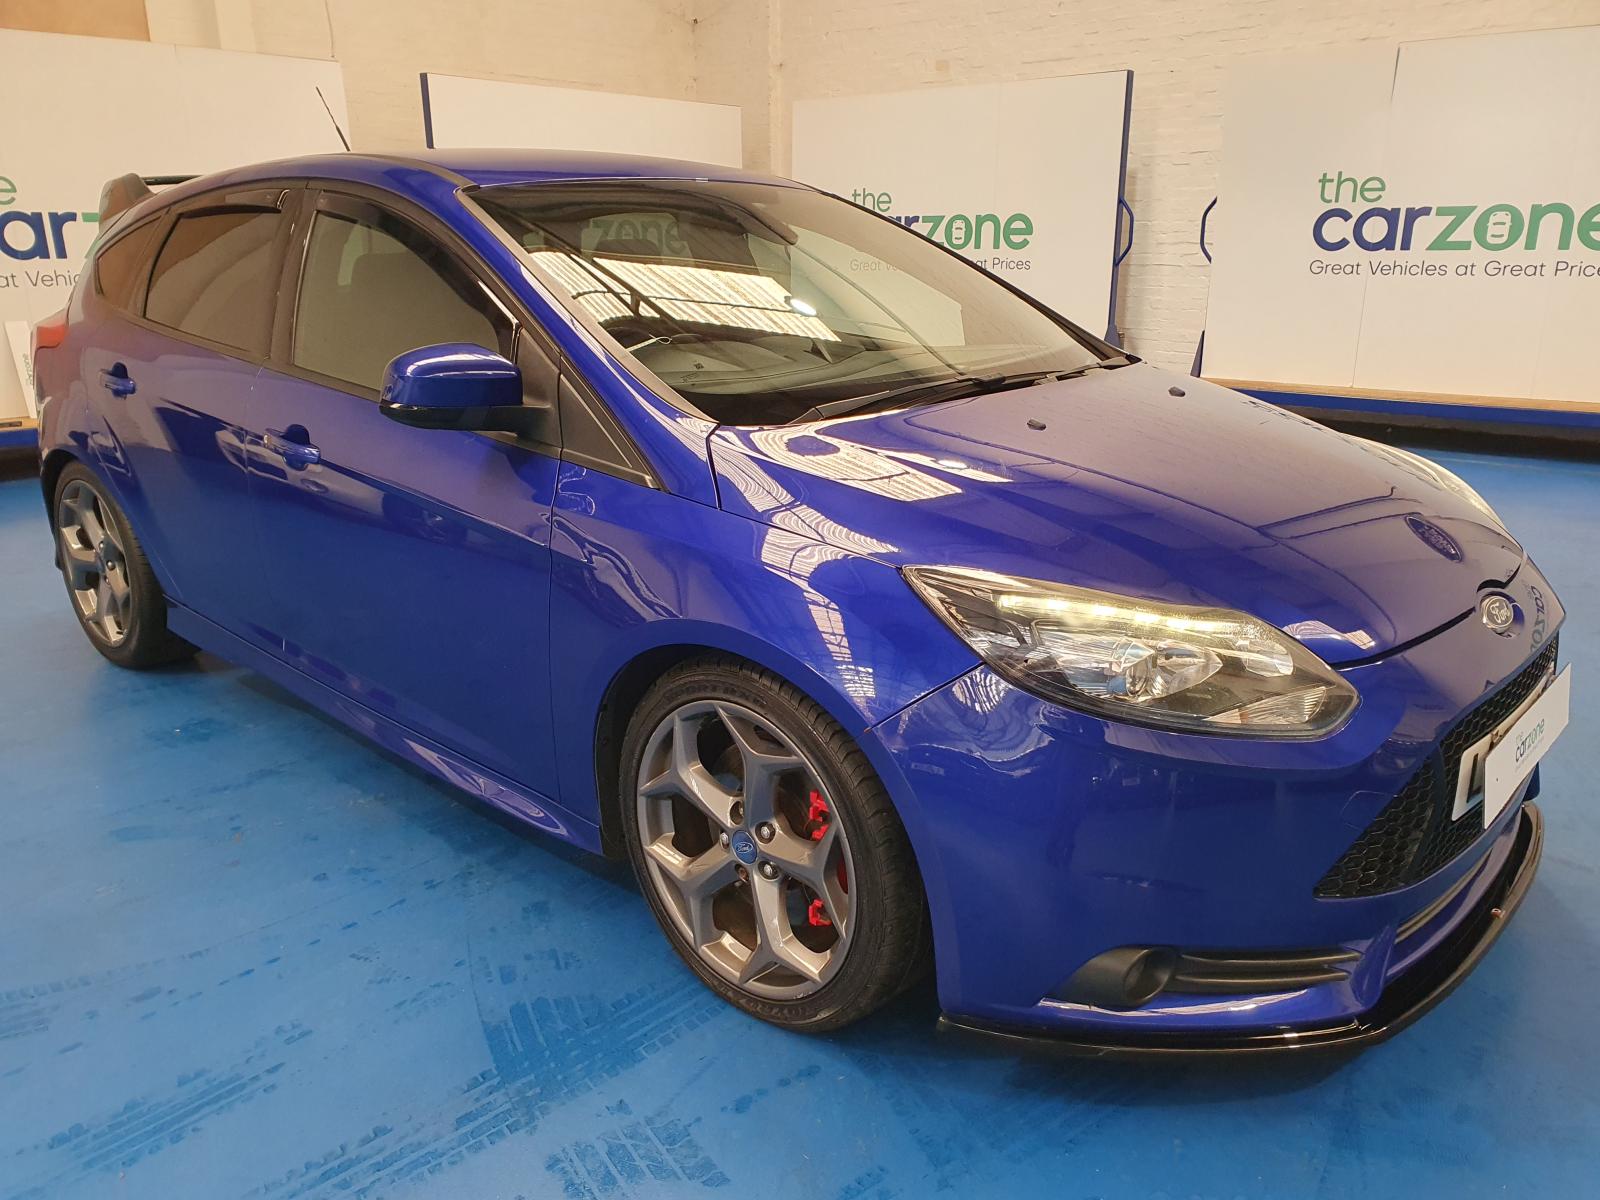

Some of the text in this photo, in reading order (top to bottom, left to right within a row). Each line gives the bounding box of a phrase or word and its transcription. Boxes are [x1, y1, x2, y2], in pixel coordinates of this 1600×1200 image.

[0, 176, 17, 205] e
[851, 187, 892, 212] the
[1318, 171, 1386, 203] the
[992, 257, 1031, 271] Prices
[1309, 259, 1600, 278] Great Vehicles at Great Pric
[0, 271, 80, 288] at Vehic
[1515, 718, 1545, 763] carzone
